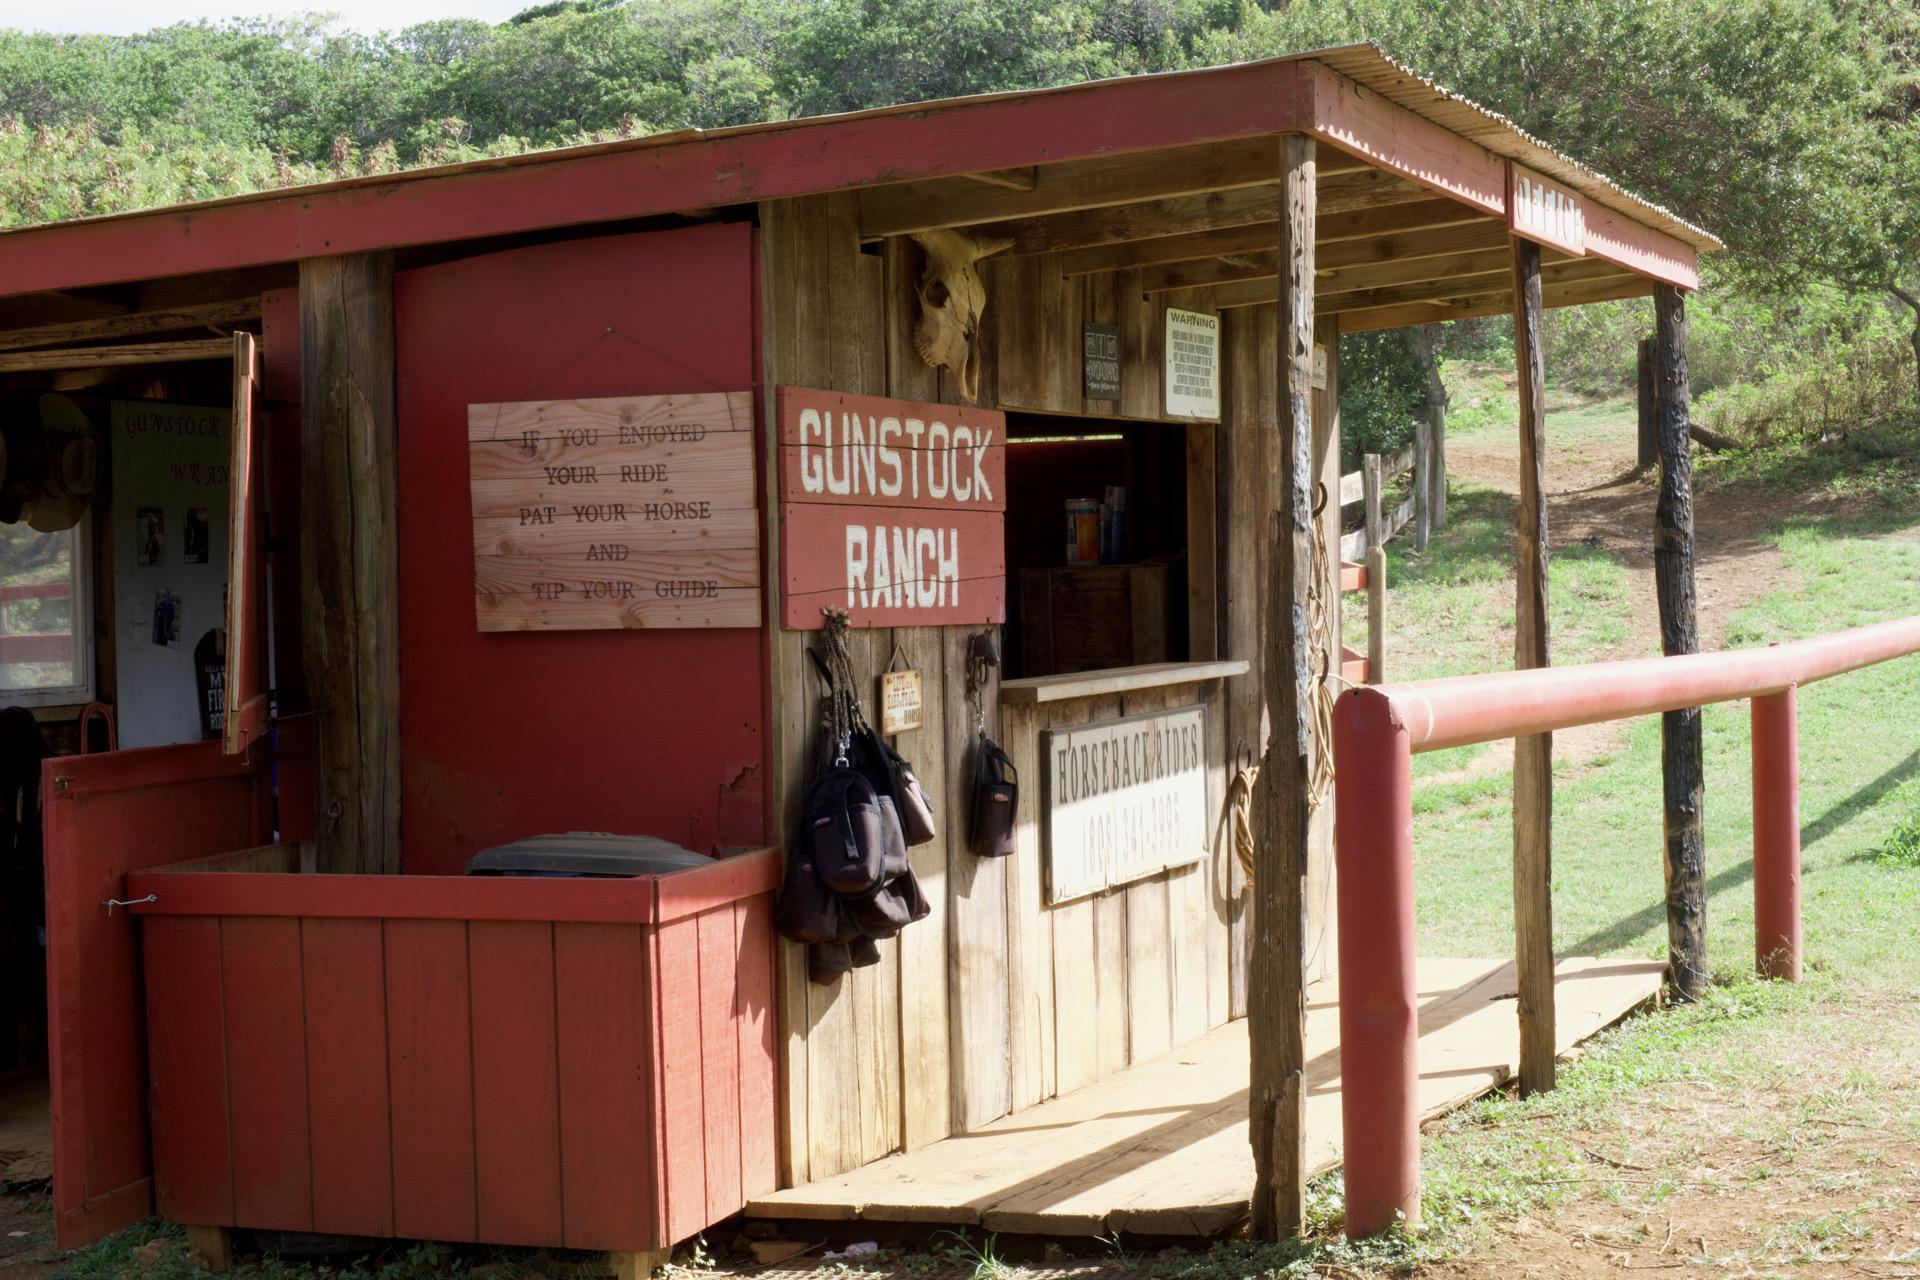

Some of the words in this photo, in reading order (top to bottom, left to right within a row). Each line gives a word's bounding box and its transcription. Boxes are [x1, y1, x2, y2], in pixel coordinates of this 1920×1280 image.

[1170, 312, 1216, 330] WARNING
[127, 413, 220, 438] GUNSTOCK
[521, 431, 541, 449] IF
[558, 428, 599, 447] YOU
[618, 424, 706, 445] ENJOYED
[799, 408, 994, 502] GUNSTOCK
[170, 462, 229, 485] WRAN
[544, 466, 599, 485] YOUR
[620, 464, 669, 483] RIDE
[519, 506, 557, 526] PAT
[572, 503, 627, 522] YOUR
[644, 501, 711, 521] HORSE
[586, 544, 629, 562] AND
[845, 524, 960, 609] RANCH
[532, 583, 565, 600] TIP
[582, 581, 636, 599] YOUR
[655, 580, 718, 599] GUIDE
[208, 689, 225, 711] FIR
[1057, 731, 1150, 804] HORSEBACK
[1156, 723, 1198, 779] RIDES
